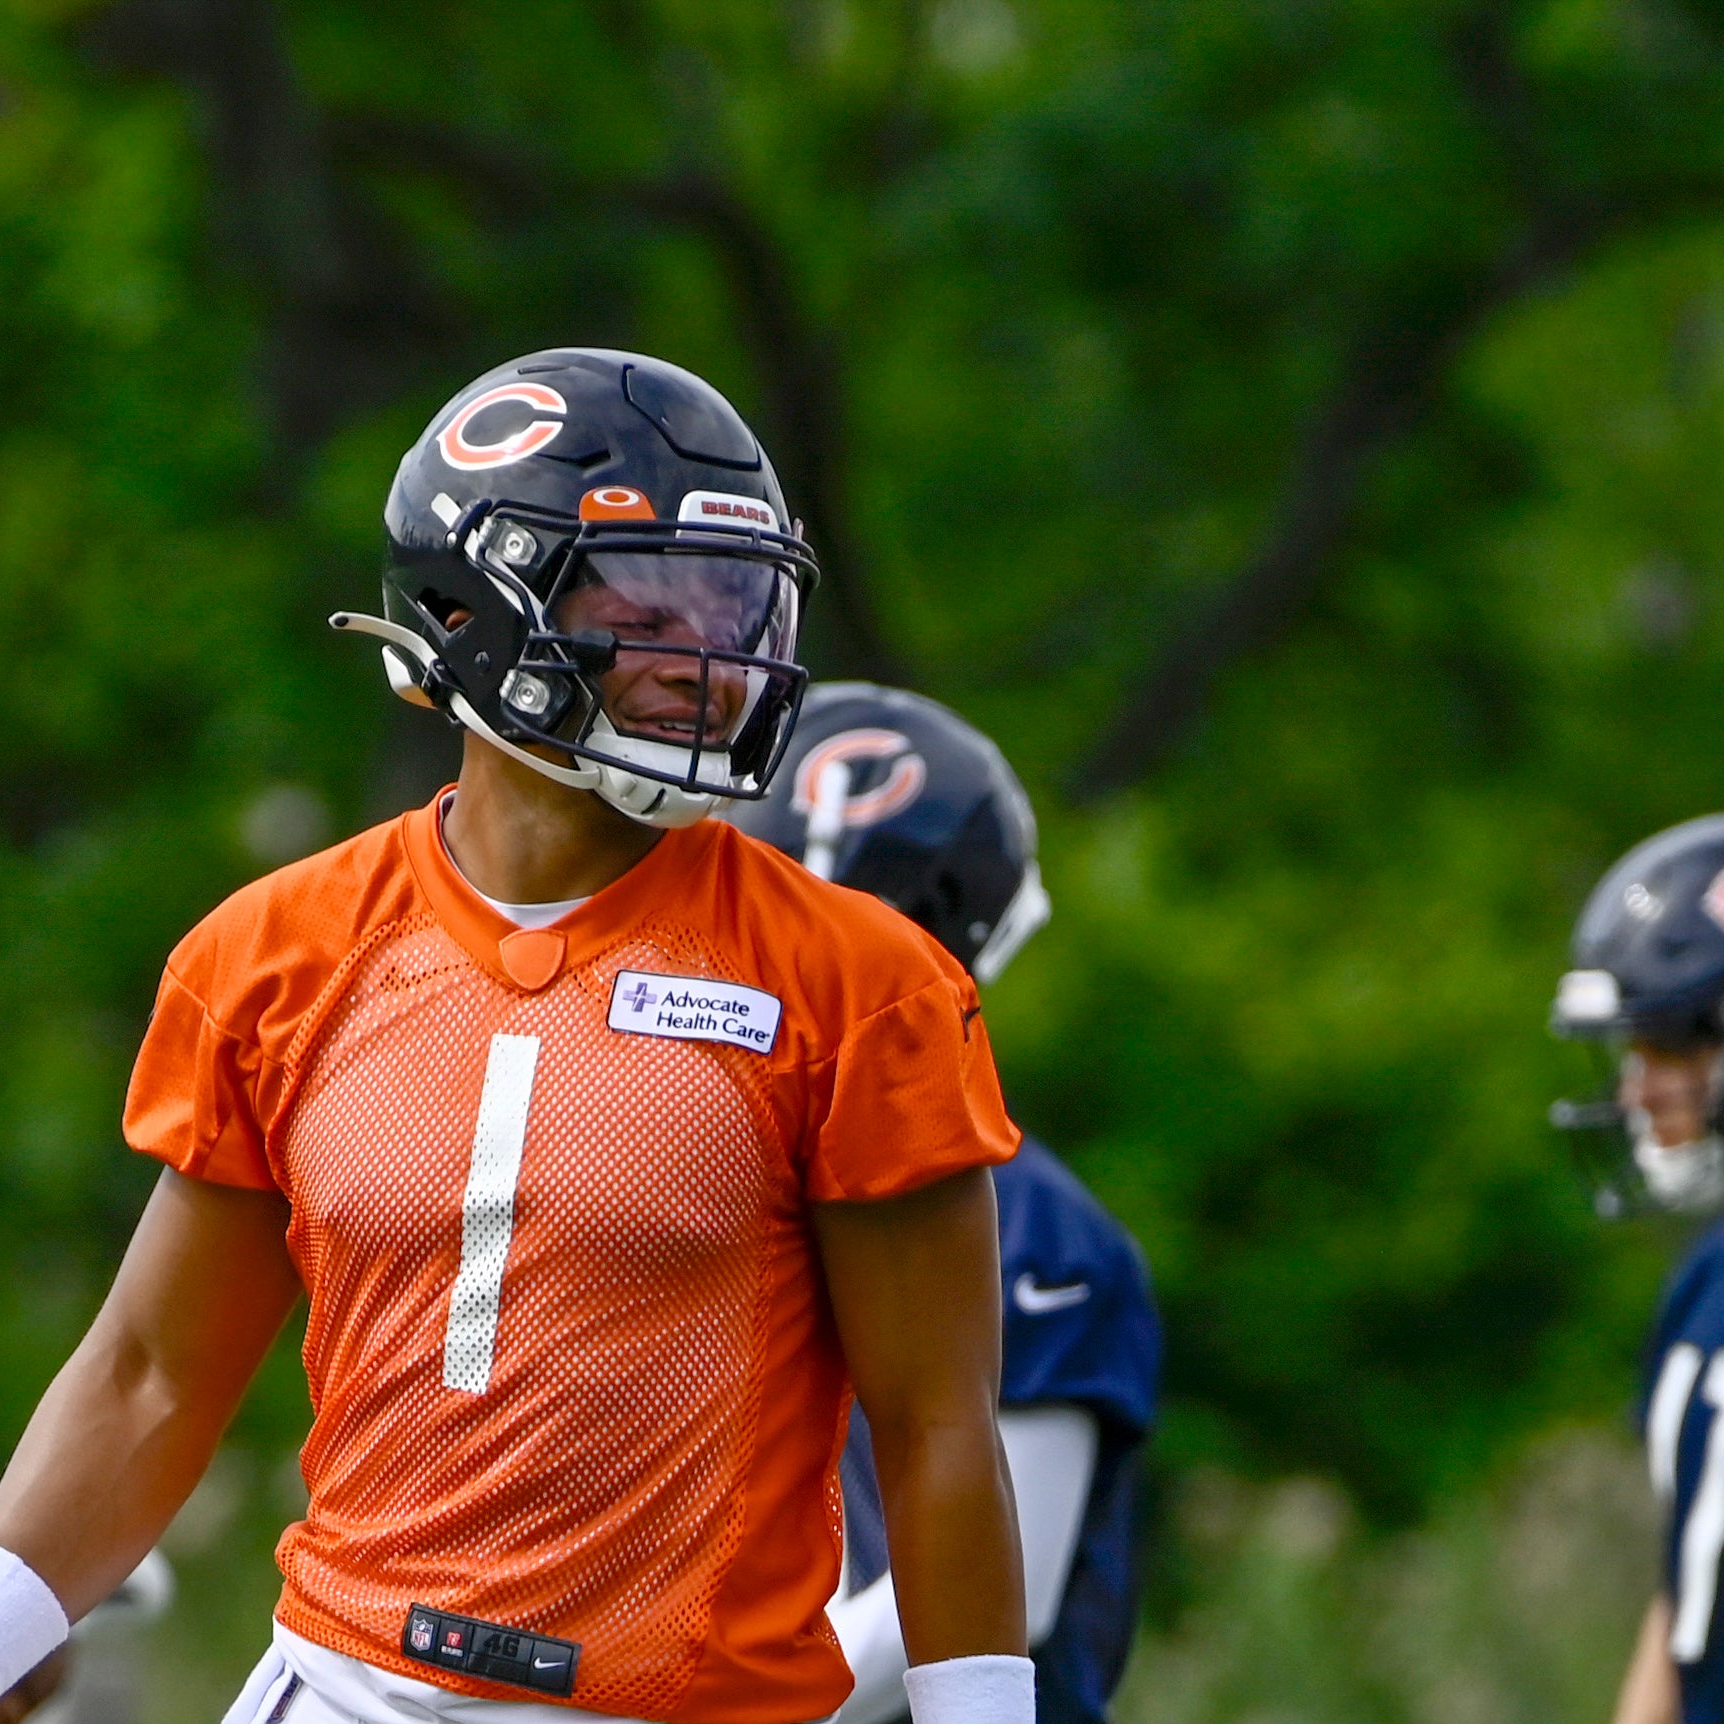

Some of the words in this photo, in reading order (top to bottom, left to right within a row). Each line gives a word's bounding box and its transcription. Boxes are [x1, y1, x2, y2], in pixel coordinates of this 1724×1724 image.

[700, 500, 771, 526] BEARS
[660, 990, 750, 1017] Advocate
[656, 1011, 718, 1031] Health
[722, 1017, 769, 1044] Care
[442, 1033, 541, 1395] 1
